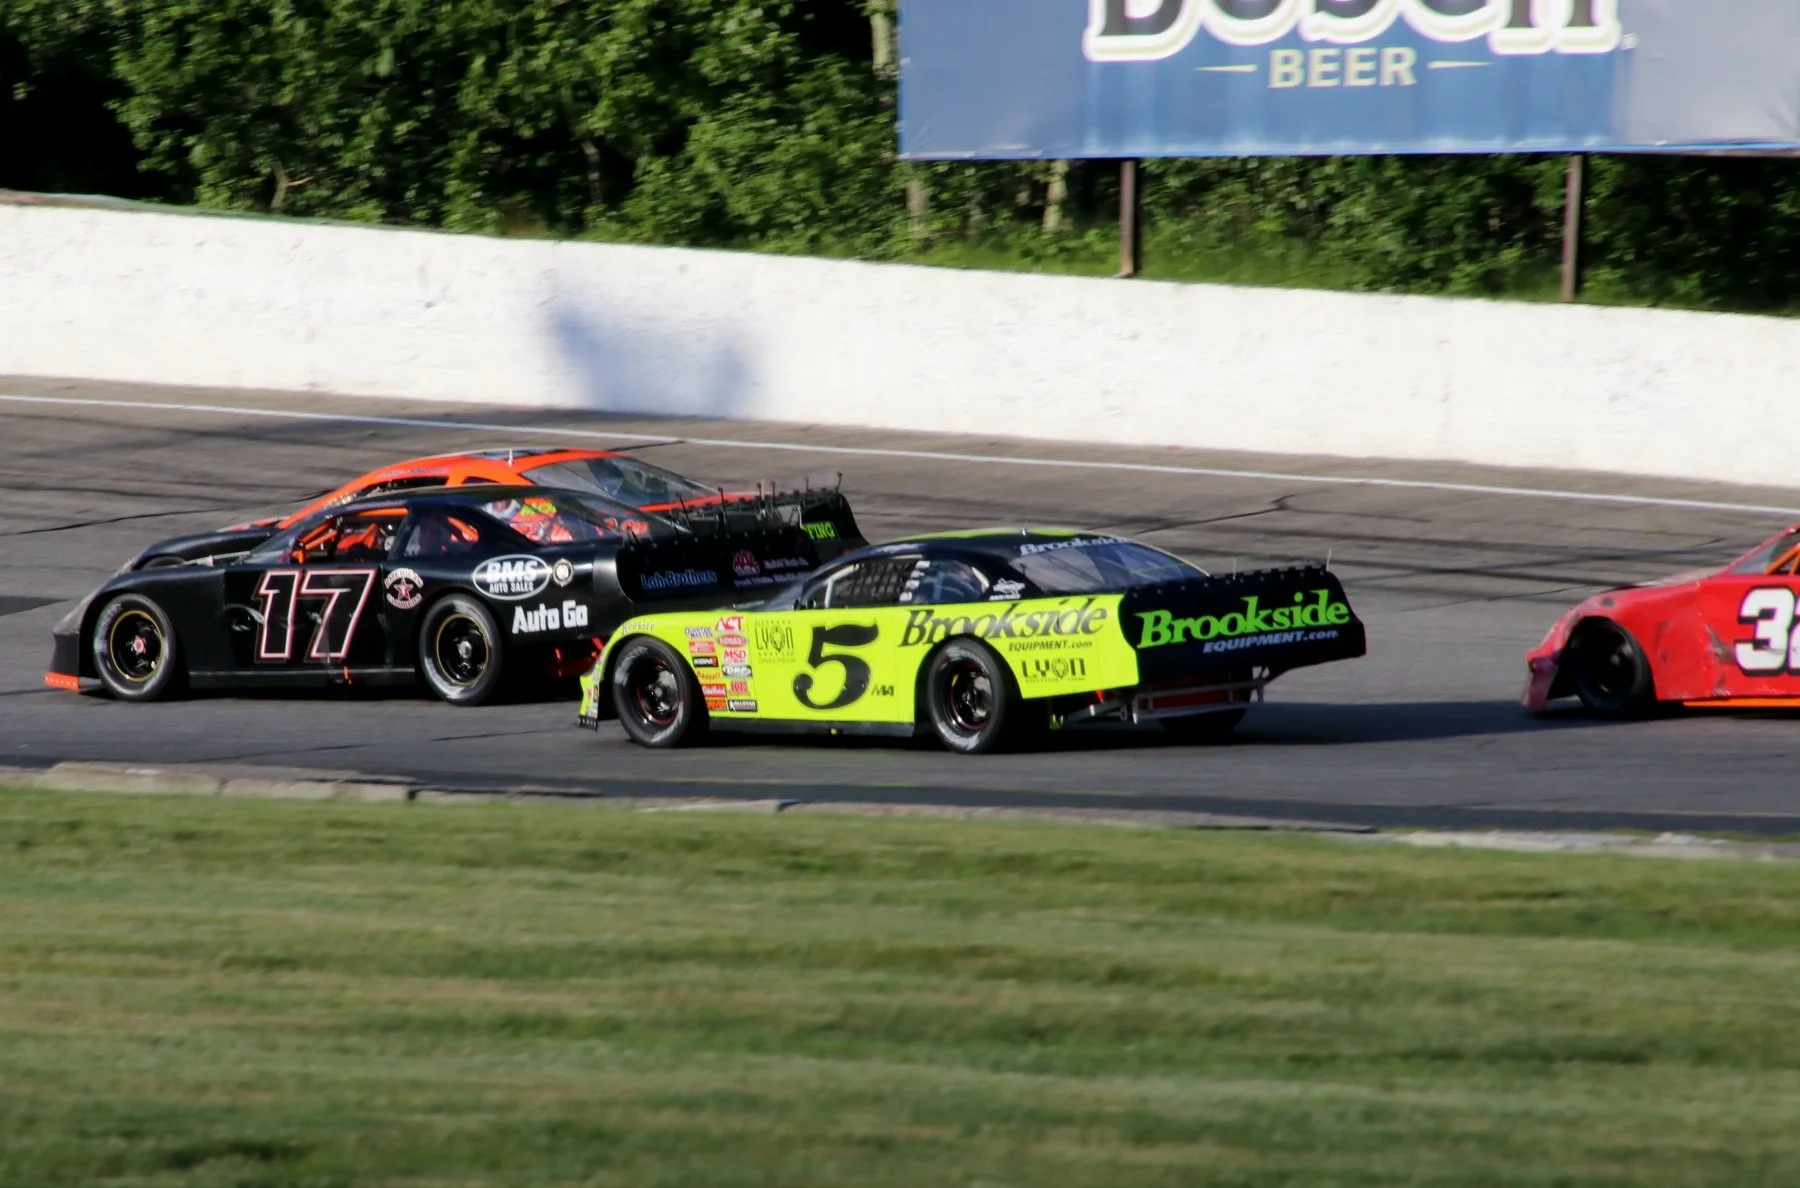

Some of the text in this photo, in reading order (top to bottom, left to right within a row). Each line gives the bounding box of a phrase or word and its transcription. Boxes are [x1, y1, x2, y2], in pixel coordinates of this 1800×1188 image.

[1268, 46, 1417, 88] BEER
[486, 560, 538, 583] BMS
[489, 582, 534, 593] AUTO SALES
[252, 568, 378, 664] 17
[512, 599, 588, 634] Auto Go
[715, 616, 745, 631] ACT
[898, 597, 1107, 647] Brookside
[1135, 589, 1349, 648] Brookside
[1008, 639, 1093, 651] EQUIPMENT.com
[1203, 629, 1339, 653] EQUIPMENT.com
[1733, 585, 1800, 677] 3
[724, 649, 746, 660] MSD
